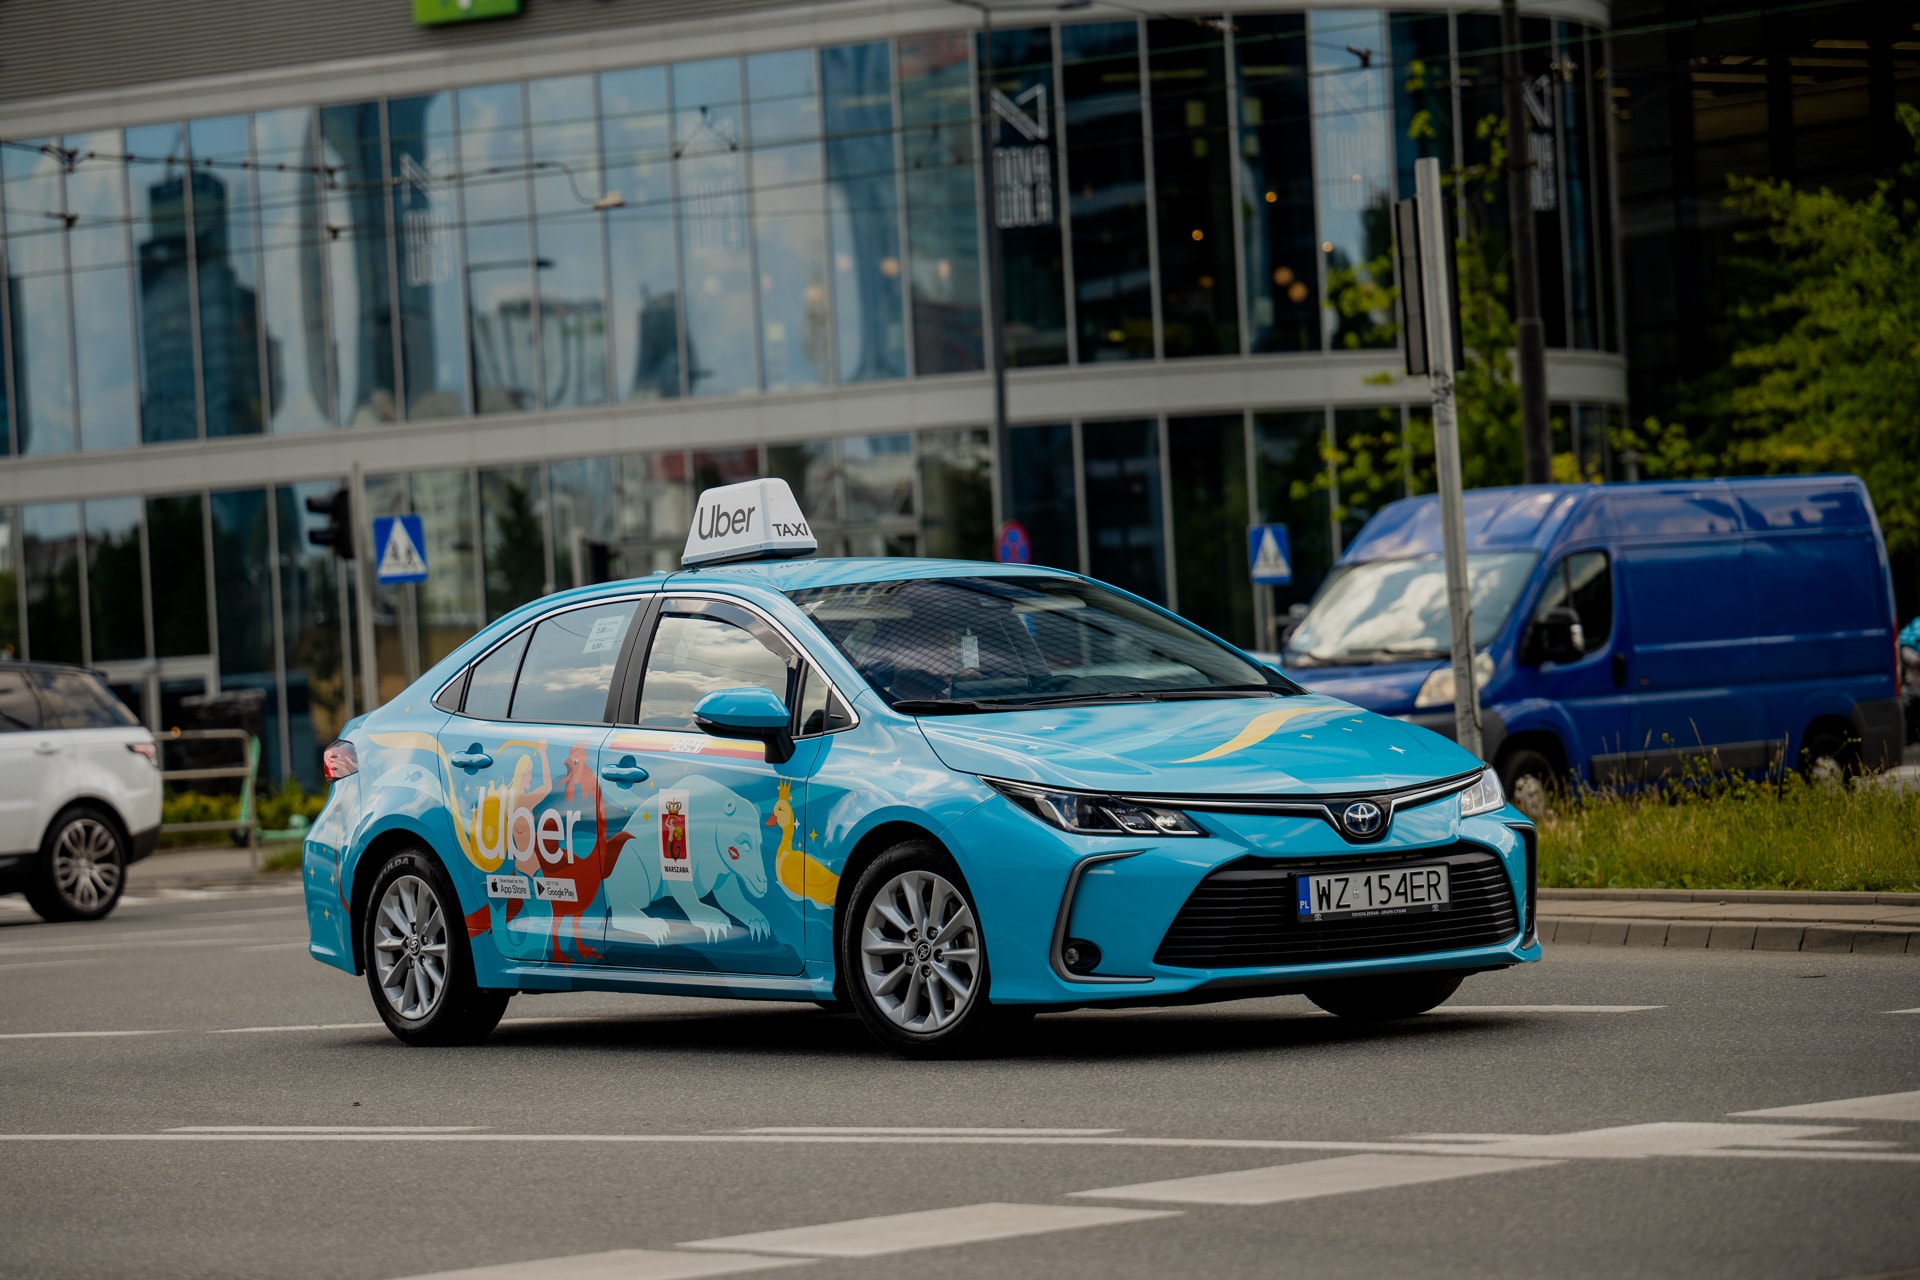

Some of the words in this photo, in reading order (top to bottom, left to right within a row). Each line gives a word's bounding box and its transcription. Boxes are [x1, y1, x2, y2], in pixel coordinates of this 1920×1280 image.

[698, 503, 756, 541] Uber
[772, 522, 809, 537] TAXI
[476, 786, 581, 864] Uber
[664, 865, 690, 874] WARSZAWA
[501, 885, 512, 895] App
[512, 885, 527, 895] Store
[547, 887, 565, 898] Google
[565, 888, 575, 898] Play
[1316, 877, 1351, 911] WZ
[1363, 870, 1442, 907] 154ER
[1299, 900, 1310, 910] PL
